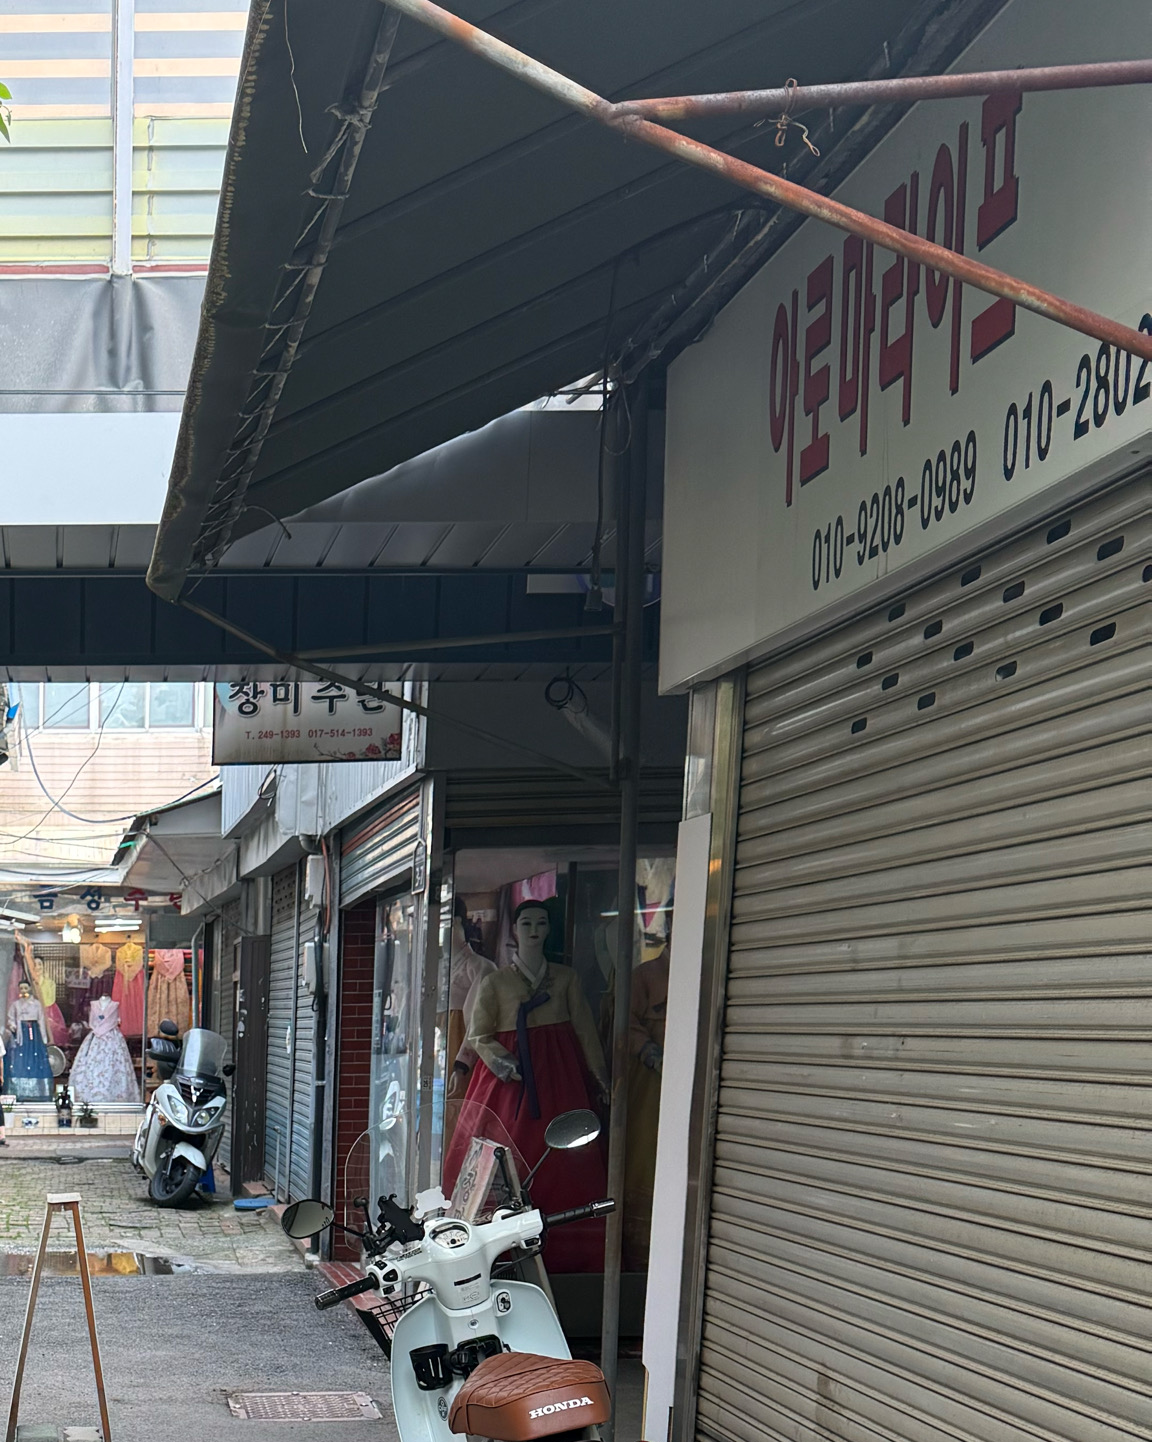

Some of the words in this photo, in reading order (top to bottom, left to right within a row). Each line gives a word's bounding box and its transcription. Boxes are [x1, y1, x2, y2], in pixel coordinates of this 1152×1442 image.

[769, 66, 1024, 508] 아로마라이프
[812, 429, 978, 592] 010-9208-0989
[307, 727, 373, 739] 017-514-1393
[528, 1396, 595, 1420] HONDA
